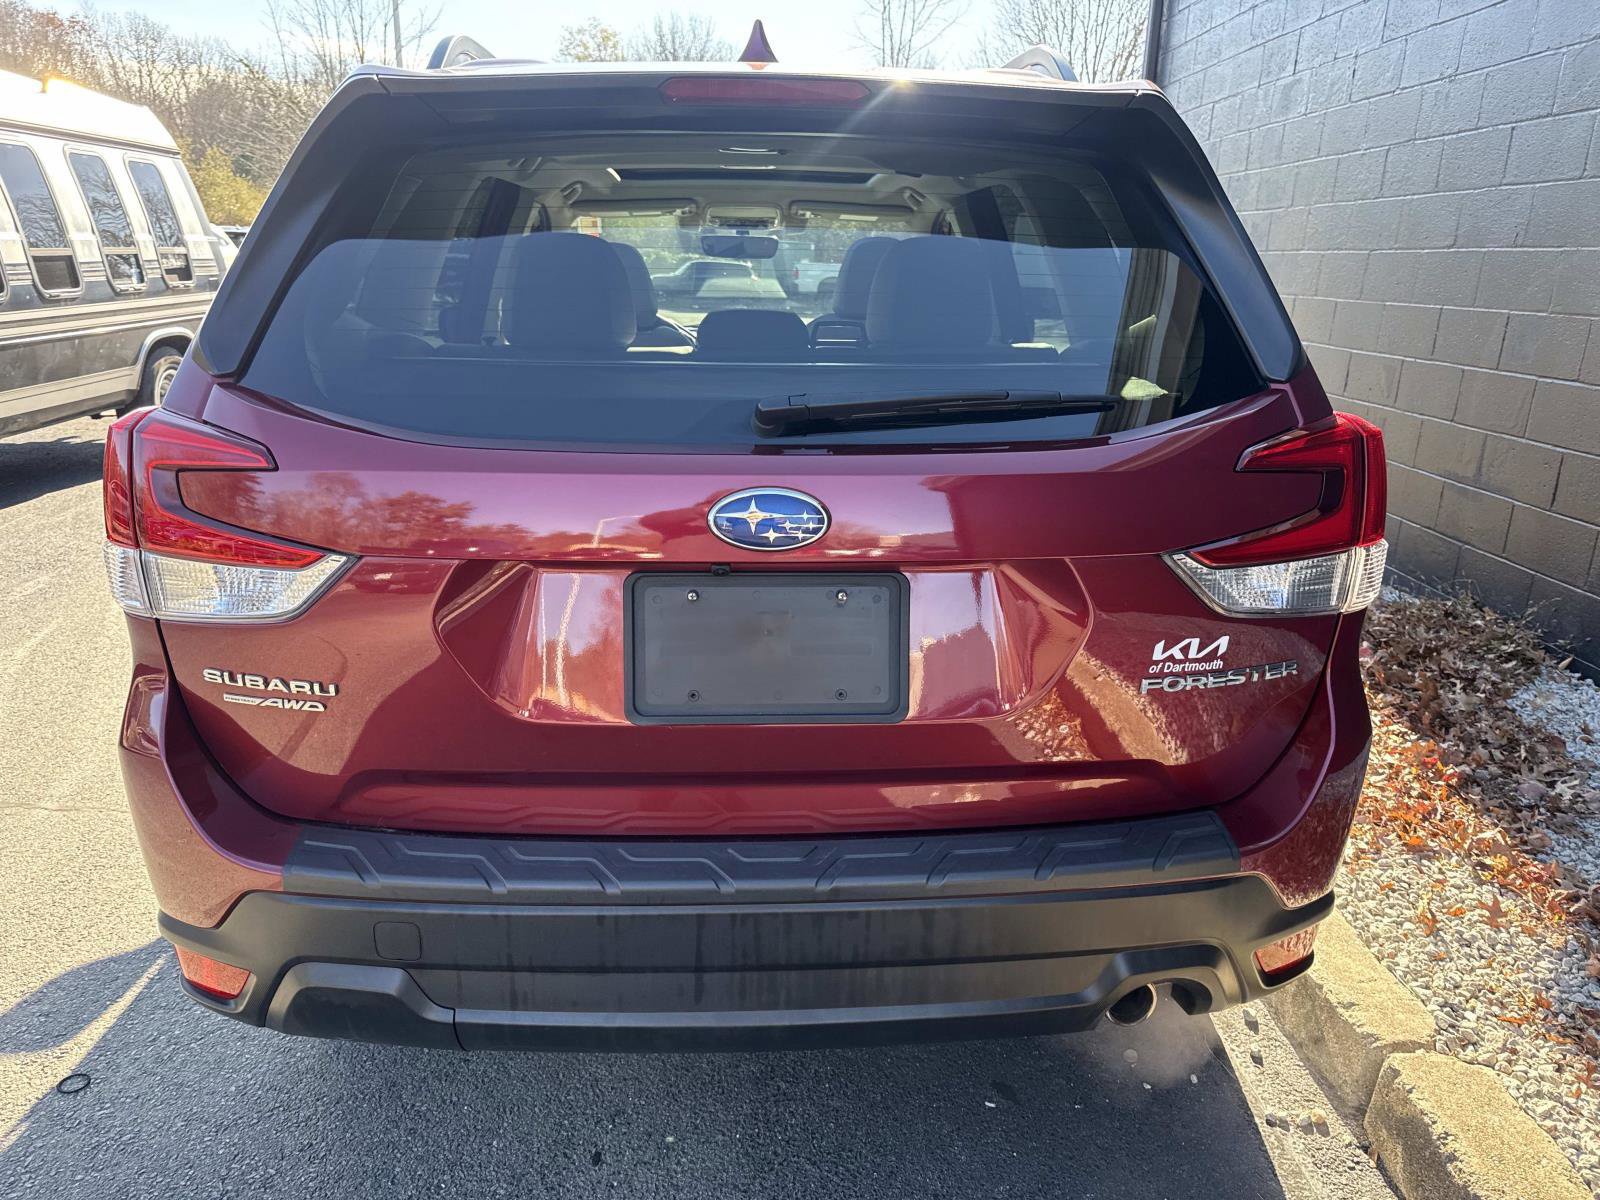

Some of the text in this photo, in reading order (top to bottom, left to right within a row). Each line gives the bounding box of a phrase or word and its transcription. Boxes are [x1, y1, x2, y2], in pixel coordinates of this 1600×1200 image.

[1152, 635, 1230, 660] KIA
[1139, 660, 1298, 695] FORESTER
[1149, 659, 1223, 674] of Dartmouth
[203, 668, 338, 696] SUBARU
[259, 698, 327, 712] AWD
